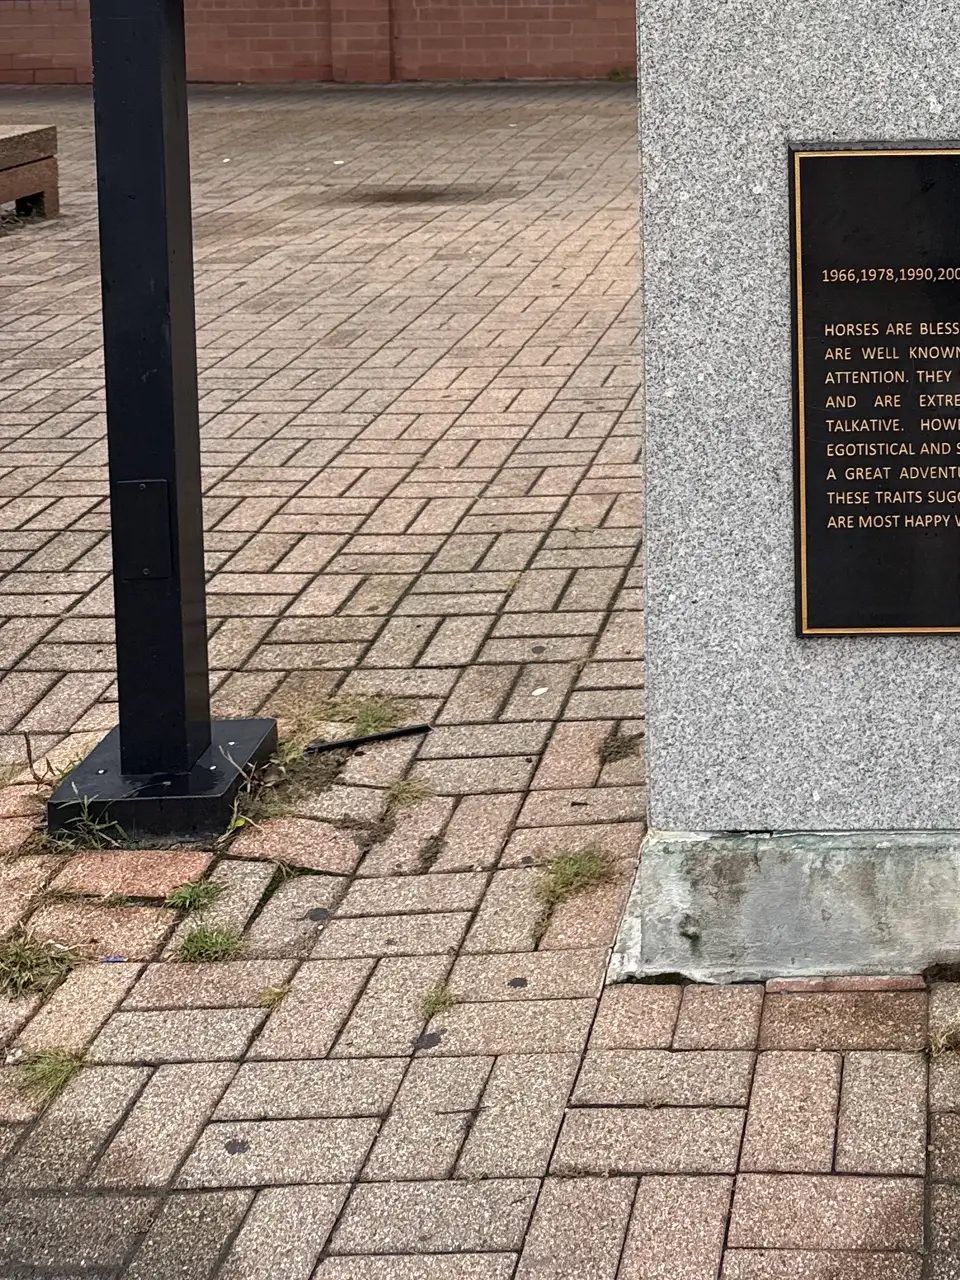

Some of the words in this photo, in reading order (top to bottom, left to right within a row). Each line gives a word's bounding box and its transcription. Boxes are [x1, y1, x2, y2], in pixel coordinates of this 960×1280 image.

[824, 323, 880, 336] HORSES
[885, 323, 913, 336] ARE
[824, 347, 852, 360] ARE
[861, 347, 900, 360] WELL
[824, 370, 909, 384] ATTENTION.
[915, 369, 953, 383] THEY
[825, 395, 857, 408] AND
[873, 395, 902, 408] ARE
[825, 419, 905, 432] TALKATIVE.
[826, 442, 916, 456] EGOTISTICAL
[919, 442, 952, 455] AND
[826, 467, 837, 480] A
[844, 467, 892, 480] GREAT
[826, 491, 870, 505] THESE
[874, 491, 923, 504] TRAITS
[826, 515, 855, 528] ARE
[858, 515, 901, 528] MOST
[904, 514, 951, 528] HAPPY
